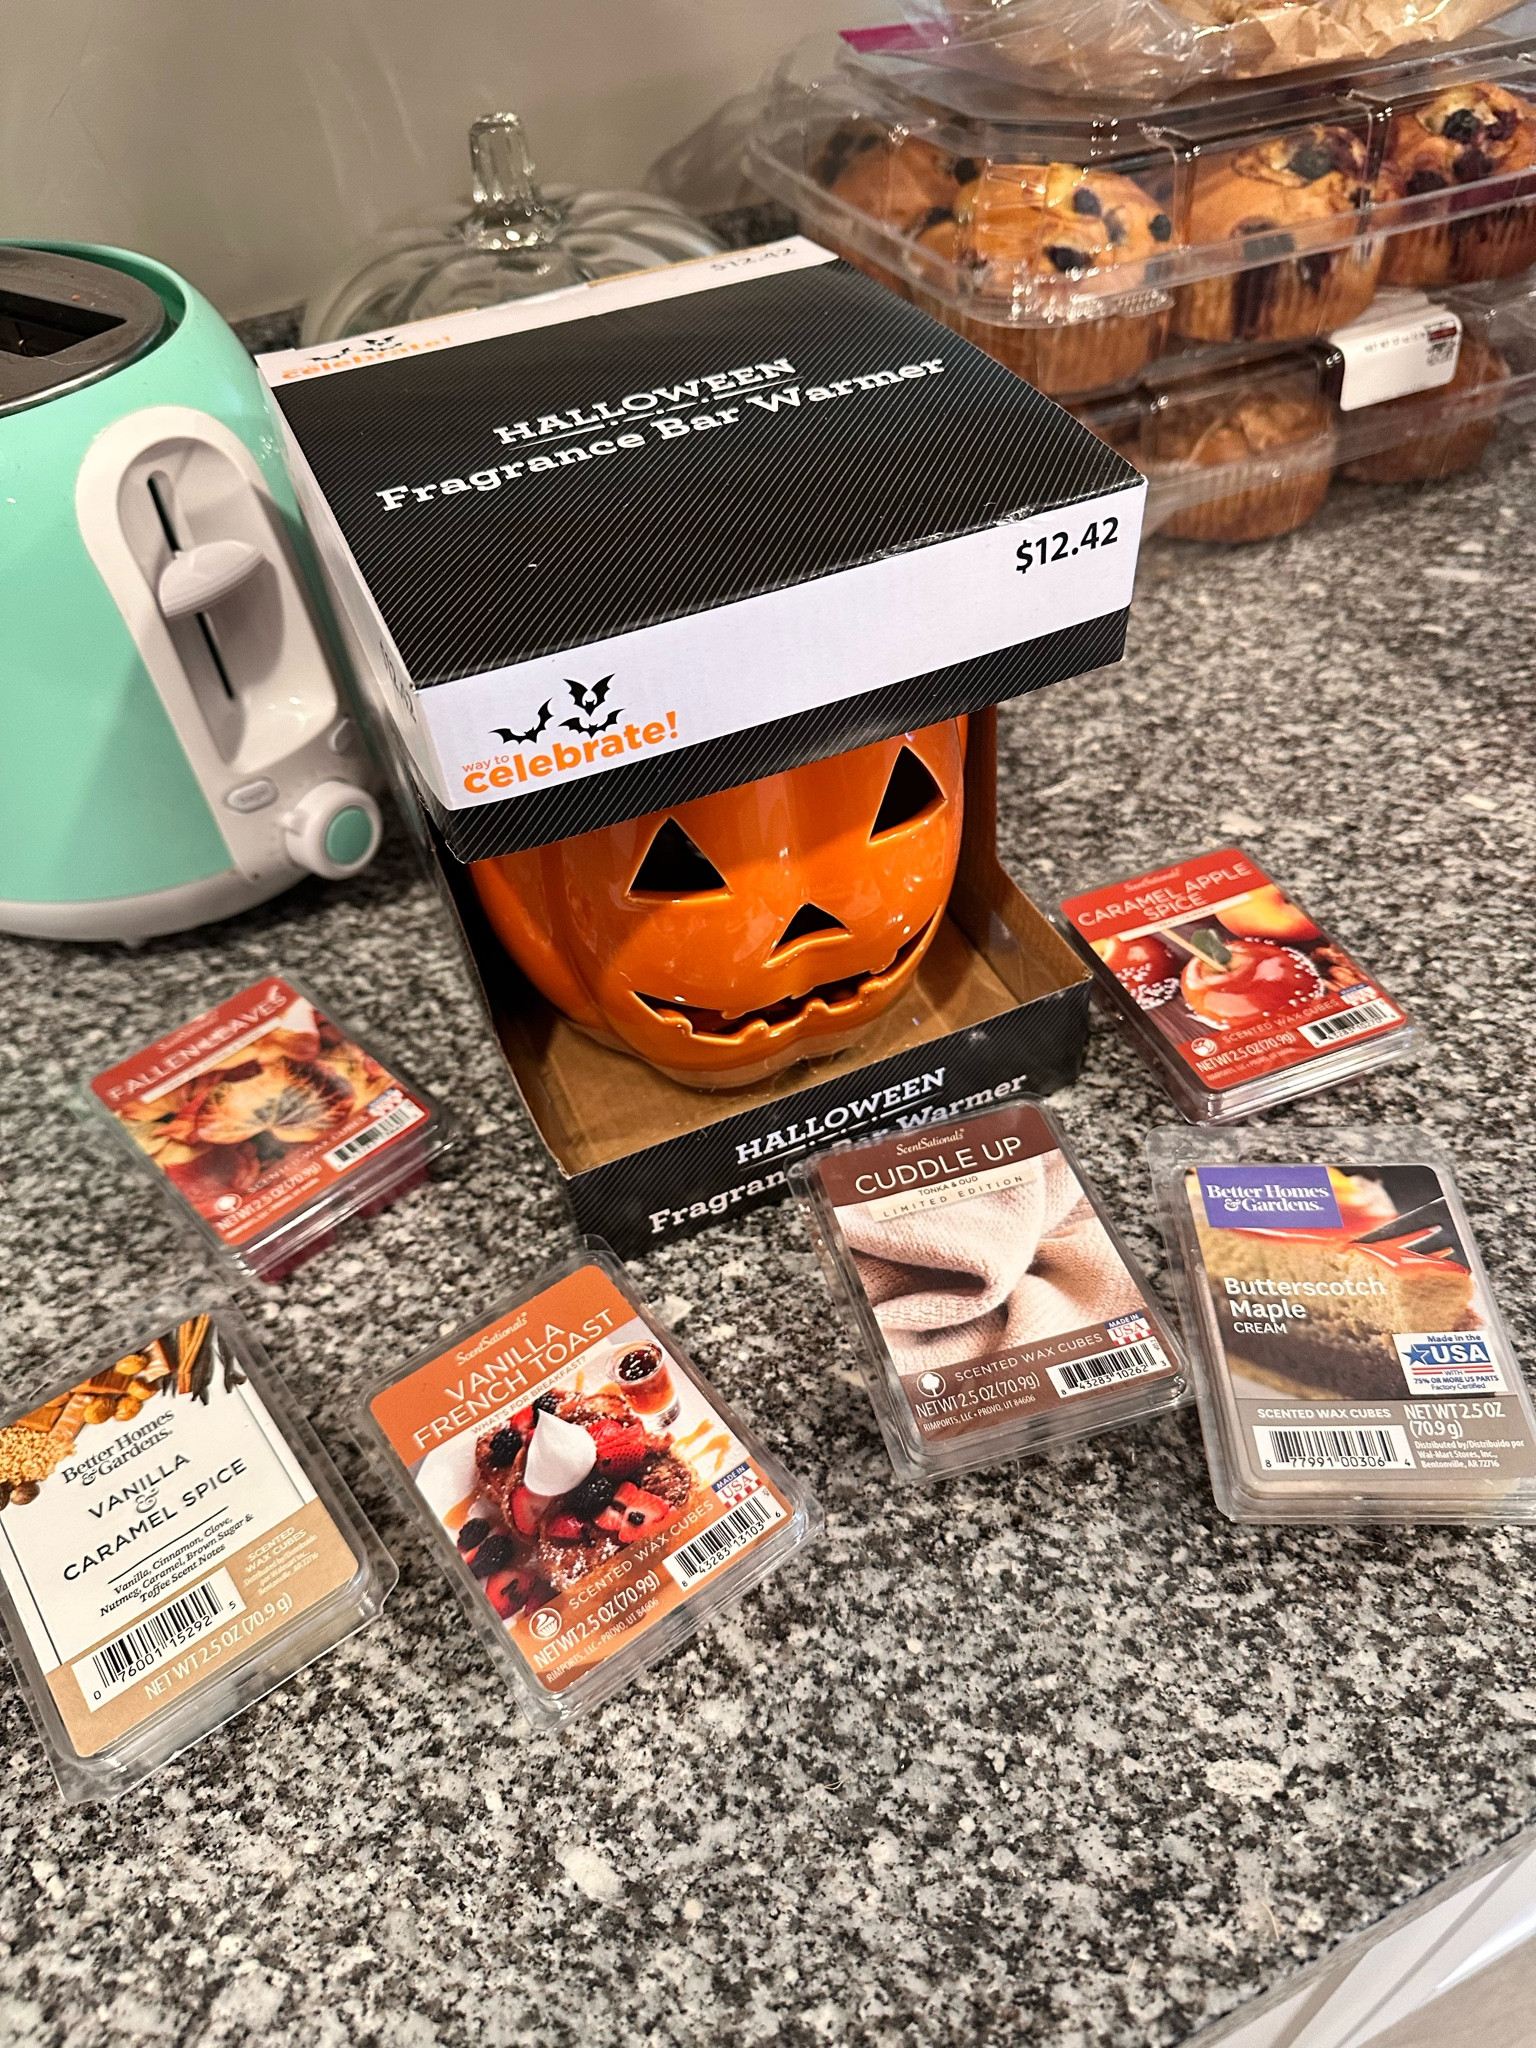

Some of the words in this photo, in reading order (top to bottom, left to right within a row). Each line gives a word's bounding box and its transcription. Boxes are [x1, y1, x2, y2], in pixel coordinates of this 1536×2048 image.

[492, 357, 797, 445] HALLOWEEN
[375, 431, 647, 512] Fragrance
[650, 407, 740, 441] Bar
[745, 357, 946, 413] Warmer
[1015, 516, 1119, 575] $12.42
[461, 757, 492, 773] way
[494, 754, 511, 766] to
[463, 710, 679, 794] celebrate!
[1077, 887, 1184, 927] CARAMEL
[1184, 861, 1253, 893] APPLE
[1143, 892, 1208, 921] SPICE
[1222, 1022, 1273, 1044] SCENTED
[1274, 1013, 1302, 1027] WAX
[1302, 999, 1340, 1017] CUBES
[105, 1043, 200, 1100] FALLEN
[735, 1066, 946, 1165] HALLOWEEN
[896, 1074, 1027, 1131] Warmer
[895, 1127, 966, 1157] ScentSationals
[854, 1147, 979, 1196] CUDDLE
[980, 1135, 1023, 1163] UP
[918, 1183, 950, 1197] TONKA
[950, 1180, 958, 1189] &
[958, 1175, 979, 1187] OUD
[882, 1195, 948, 1218] LIMITED
[957, 1174, 1024, 1198] EDITION
[1205, 1184, 1264, 1199] Better
[1263, 1184, 1330, 1199] Homes
[1223, 1276, 1387, 1297] Butterscotch
[1107, 1316, 1130, 1329] MADE
[1129, 1312, 1140, 1321] IN
[1111, 1320, 1146, 1339] USA
[1229, 1298, 1308, 1323] Maple
[1233, 1321, 1289, 1335] CREAM
[455, 1311, 528, 1366] ScentSationals
[953, 1356, 1019, 1383] SCENTED
[1020, 1346, 1057, 1365] WAX
[1057, 1332, 1104, 1354] CUBES
[1426, 1335, 1453, 1343] Made
[1455, 1334, 1464, 1342] in
[1429, 1343, 1490, 1364] USA
[412, 1368, 530, 1450] FRENCH
[528, 1307, 616, 1374] TOAST
[444, 1322, 566, 1402] VANILLA
[1078, 1374, 1113, 1390] 43283
[1115, 1363, 1149, 1380] 10262
[1442, 1376, 1464, 1384] MORE
[1475, 1375, 1499, 1383] PARTS
[471, 1407, 510, 1435] WHAT'S
[510, 1394, 530, 1413] FOR
[530, 1355, 588, 1398] BREAKFAST?
[915, 1400, 940, 1419] NET
[936, 1395, 959, 1415] WT
[957, 1390, 979, 1409] 2.5
[978, 1384, 998, 1401] OZ
[996, 1371, 1041, 1399] (70.9g)
[1457, 1382, 1486, 1390] Certified
[960, 1411, 974, 1423] LLC
[977, 1403, 1005, 1418] PROVO,
[1003, 1400, 1014, 1410] UT
[1257, 1408, 1315, 1419] SCENTED
[1315, 1408, 1348, 1419] WAX
[1349, 1408, 1392, 1418] CUBES
[1403, 1403, 1431, 1420] NET
[1430, 1403, 1460, 1419] WT
[1460, 1402, 1483, 1419] 2.5
[1483, 1401, 1506, 1418] OZ
[61, 1445, 116, 1484] Better
[114, 1409, 176, 1451] Homes
[1265, 1459, 1272, 1468] 8
[1290, 1456, 1334, 1468] 77991
[1340, 1456, 1385, 1468] 00306
[1404, 1458, 1411, 1467] 4
[1414, 1441, 1456, 1449] Distributed
[1420, 1460, 1467, 1469] Bentonville,
[1467, 1460, 1479, 1468] AR
[88, 1453, 192, 1519] VANILLA
[135, 1486, 160, 1514] &
[716, 1472, 738, 1490] MADE
[737, 1465, 746, 1475] IN
[720, 1474, 754, 1499] USA
[63, 1506, 179, 1582] CARAMEL
[181, 1457, 248, 1508] SPICE
[99, 1587, 142, 1617] Nutmeg,
[142, 1558, 186, 1589] Caramel,
[186, 1540, 218, 1566] Brown
[217, 1518, 245, 1542] Sugar
[245, 1512, 255, 1523] &
[113, 1566, 152, 1596] Vanilla,
[152, 1537, 204, 1570] Cinnamon,
[204, 1516, 233, 1538] Clove,
[244, 1552, 272, 1573] WAX
[272, 1528, 307, 1556] CUBES
[247, 1526, 296, 1562] SCENTED
[568, 1559, 633, 1609] SCENTED
[634, 1534, 670, 1562] WAX
[669, 1499, 715, 1536] CUBES
[698, 1546, 731, 1575] 43283
[733, 1521, 765, 1548] 13103
[139, 1576, 172, 1604] Toffee
[171, 1560, 199, 1584] Scent
[198, 1543, 226, 1567] Notes
[533, 1640, 561, 1669] NET
[555, 1627, 580, 1653] WT
[576, 1613, 601, 1640] 2.5
[597, 1600, 619, 1623] OZ
[613, 1570, 661, 1612] (70.9g)
[584, 1642, 599, 1655] LLC
[600, 1620, 629, 1644] PROVO,
[625, 1612, 638, 1625] UT
[93, 1689, 102, 1701] 0
[117, 1647, 164, 1683] 76001
[169, 1614, 213, 1648] 15292
[228, 1599, 237, 1610] 5
[144, 1670, 175, 1700] NET
[172, 1653, 200, 1680] WT
[198, 1642, 222, 1664] 2.5
[221, 1625, 244, 1648] OZ
